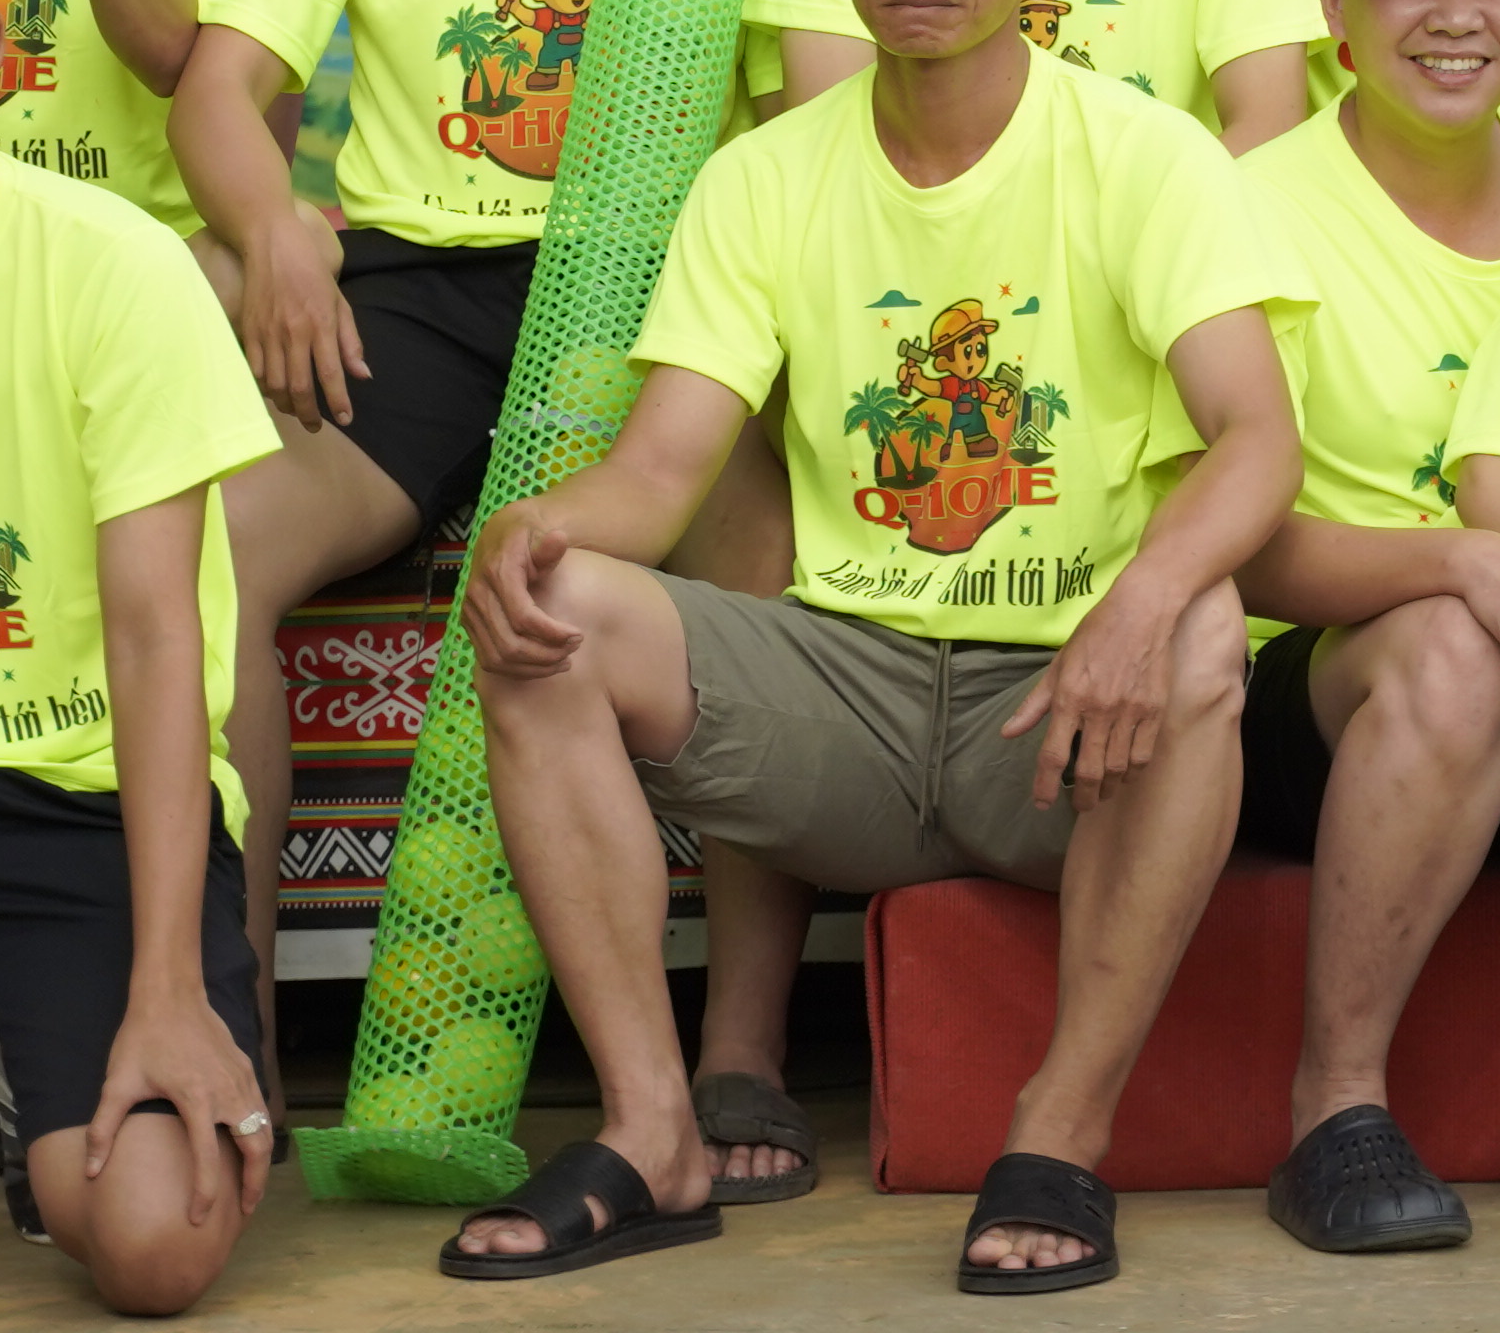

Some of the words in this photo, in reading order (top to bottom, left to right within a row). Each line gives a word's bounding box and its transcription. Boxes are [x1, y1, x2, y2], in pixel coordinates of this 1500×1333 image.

[1007, 557, 1044, 607] tới
[1053, 546, 1096, 605] bến
[46, 676, 106, 731] bến
